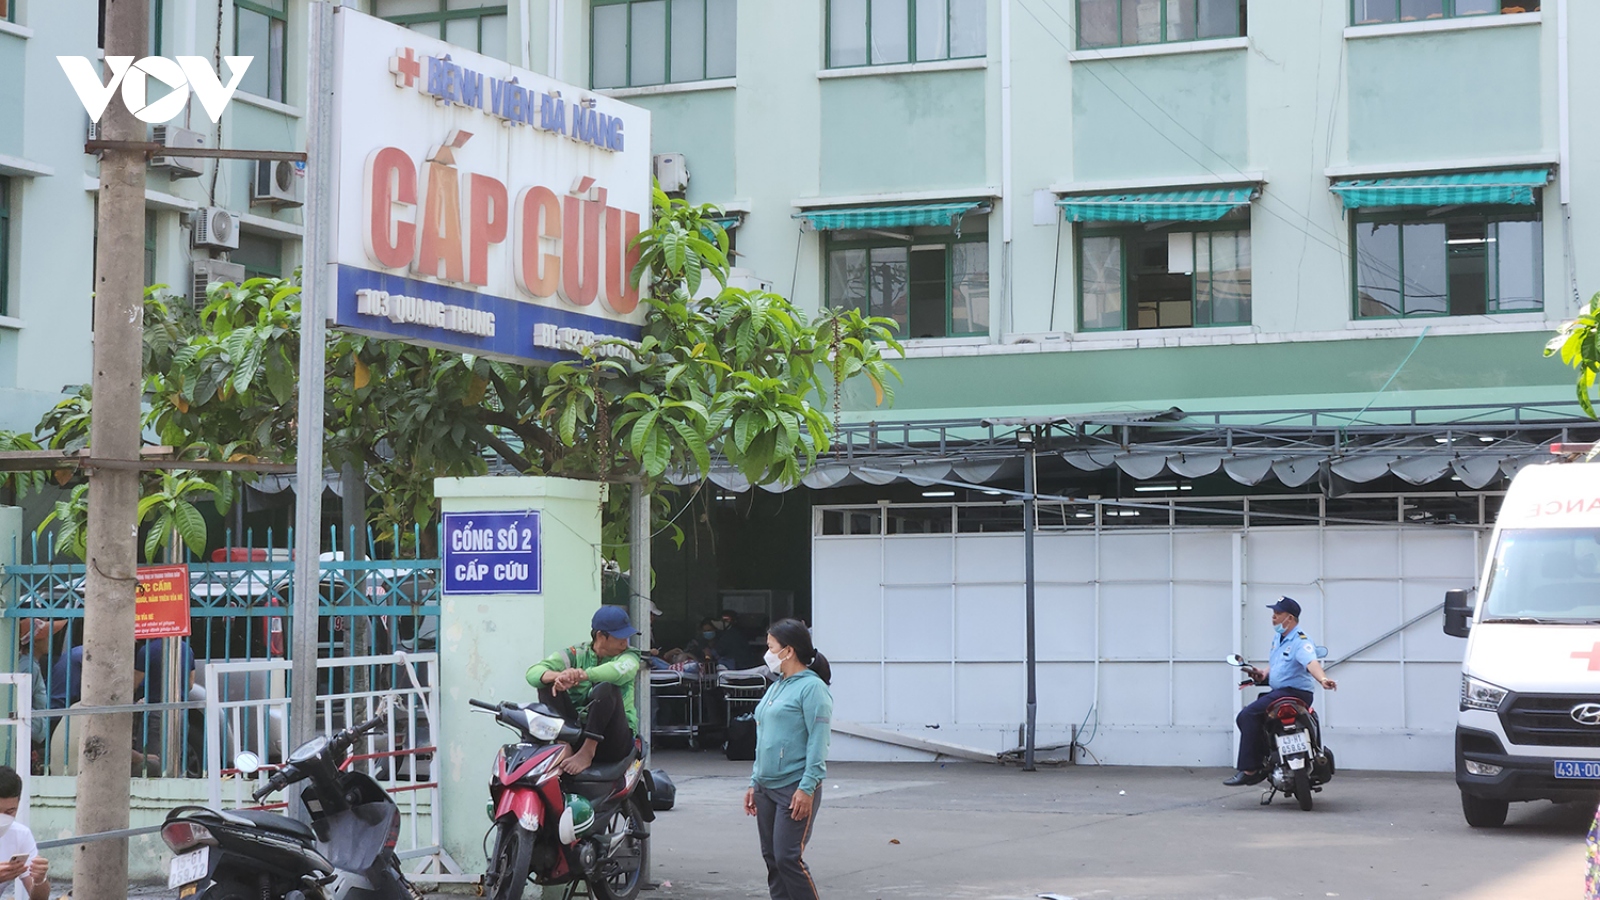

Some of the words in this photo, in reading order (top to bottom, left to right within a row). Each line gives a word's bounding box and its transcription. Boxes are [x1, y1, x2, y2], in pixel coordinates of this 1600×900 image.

[426, 53, 484, 110] BỆNH
[488, 76, 535, 127] VIỆN
[539, 90, 567, 136] ĐÀ
[368, 130, 508, 287] CẤP
[519, 176, 640, 315] CỨU
[357, 289, 390, 316] 103
[393, 295, 445, 328] QUANG
[446, 305, 496, 337] TRUNG
[452, 520, 494, 551] CỔNG
[497, 521, 518, 551] SỐ
[521, 528, 532, 550] 2
[152, 580, 172, 592] CẤM
[455, 558, 489, 581] CẤP
[493, 560, 528, 581] CỨU
